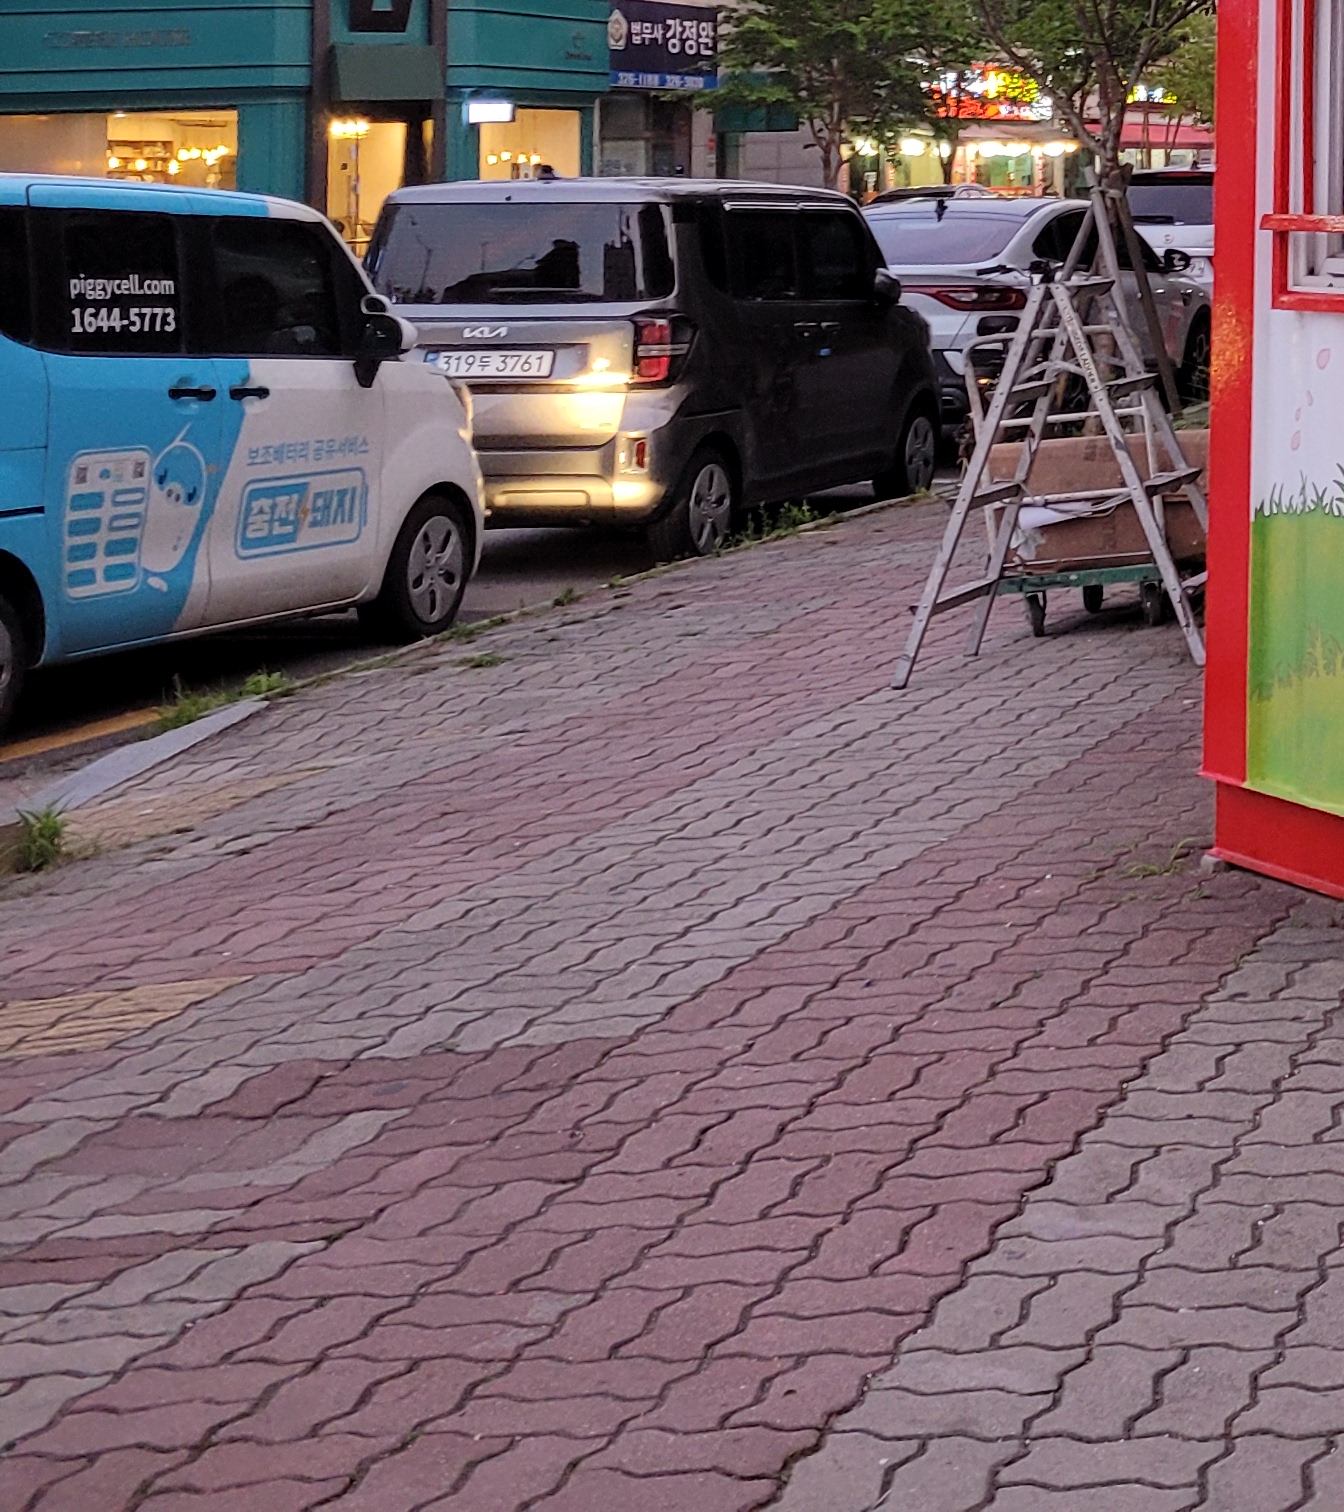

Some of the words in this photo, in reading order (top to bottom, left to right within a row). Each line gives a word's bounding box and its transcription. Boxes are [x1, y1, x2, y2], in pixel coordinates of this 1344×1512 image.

[630, 20, 664, 46] 법무사
[665, 17, 715, 55] 강정완
[69, 273, 175, 300] piggycell.com
[71, 307, 176, 333] 1644-5773
